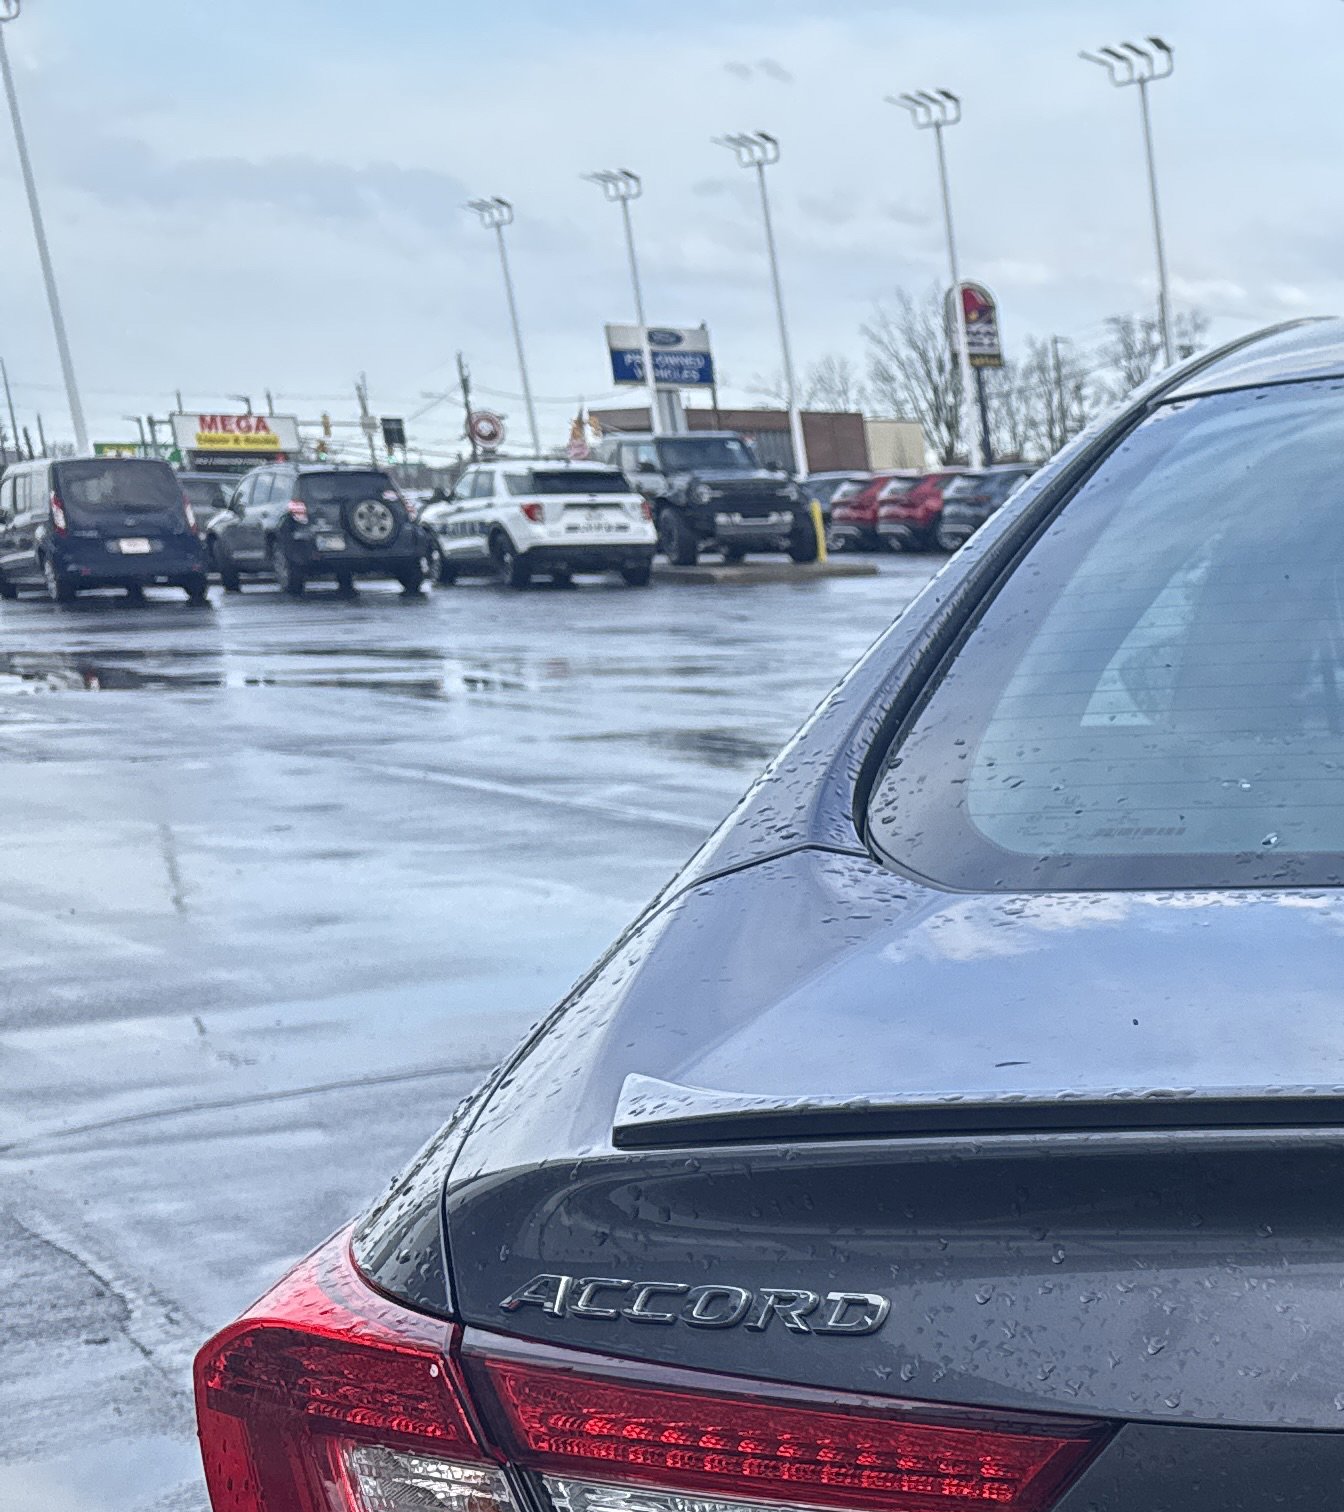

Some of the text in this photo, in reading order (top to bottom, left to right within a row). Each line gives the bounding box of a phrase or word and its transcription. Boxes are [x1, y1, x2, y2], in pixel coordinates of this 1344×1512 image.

[633, 361, 700, 380] VHICLES
[198, 415, 270, 434] MEGA
[499, 1273, 892, 1336] ACCORD
